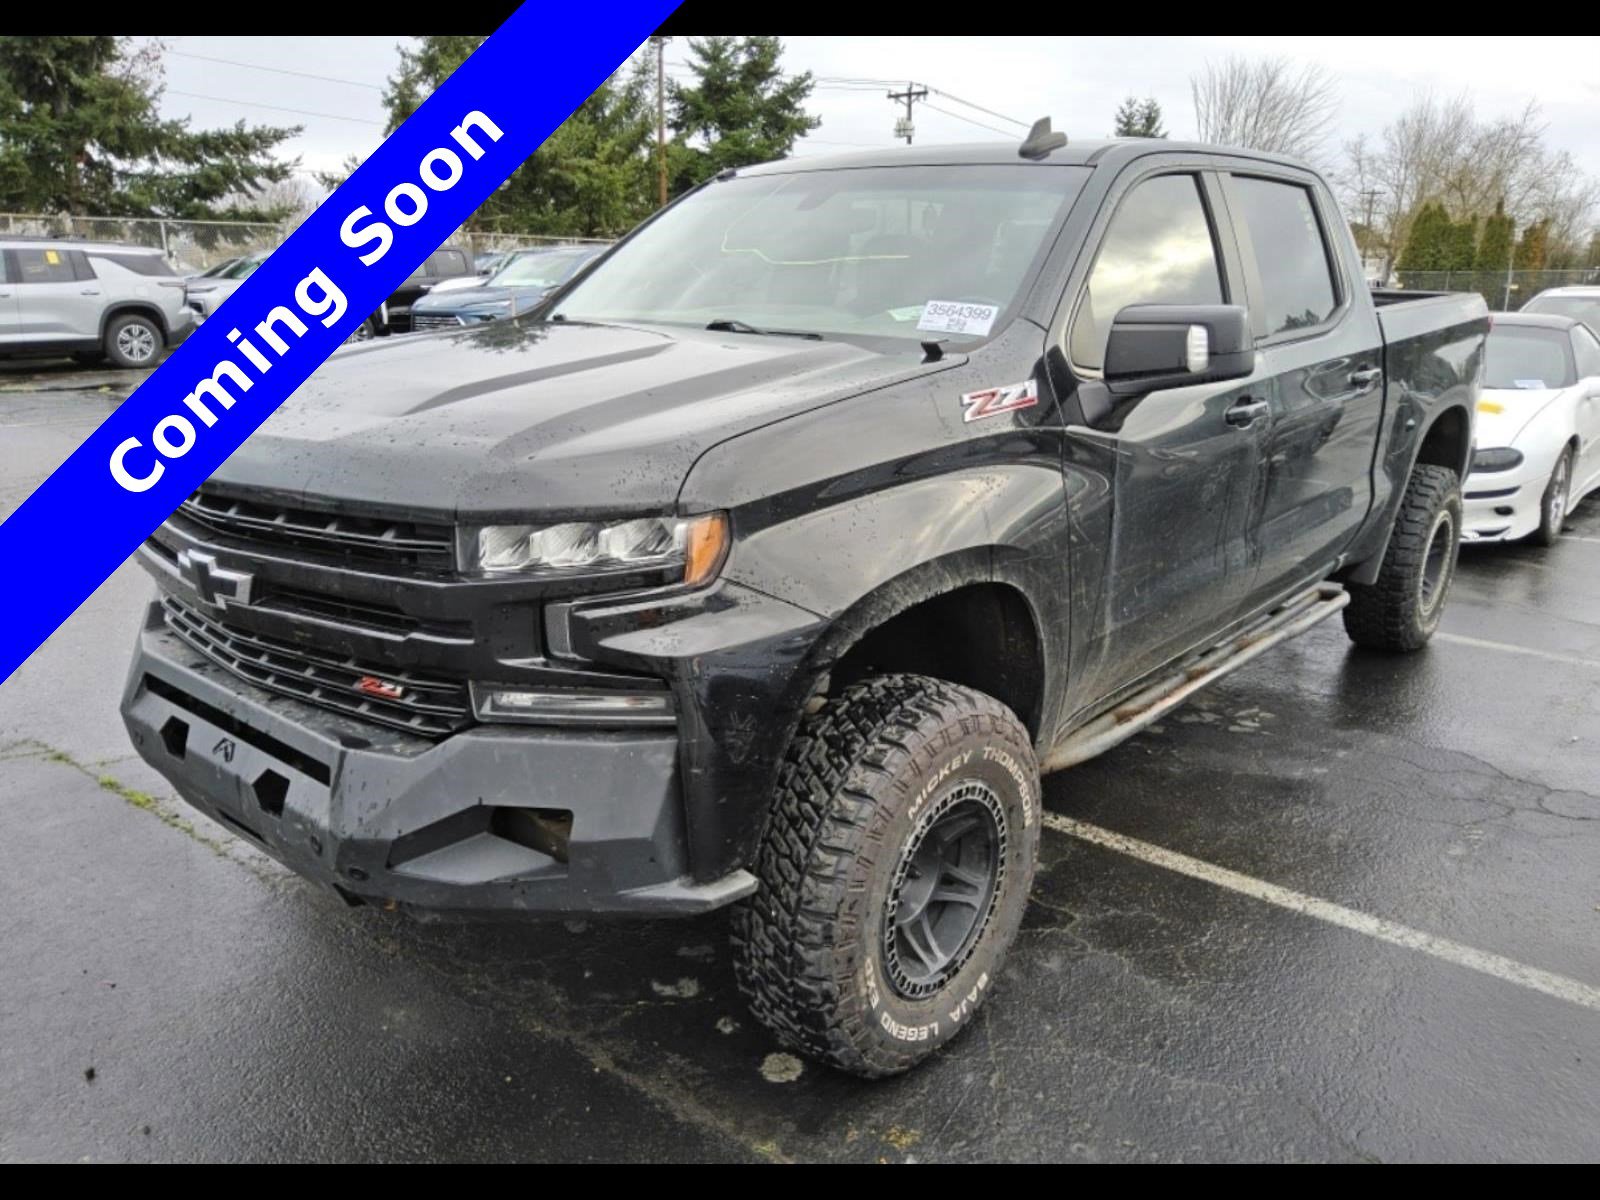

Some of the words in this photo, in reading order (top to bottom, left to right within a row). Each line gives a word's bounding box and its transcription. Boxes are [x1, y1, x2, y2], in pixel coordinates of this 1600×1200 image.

[927, 303, 992, 321] 3564399
[961, 379, 1038, 422] Z71
[907, 749, 973, 820] MICKEY
[982, 746, 1033, 828] THOMPSON
[880, 1010, 939, 1042] LEGEND
